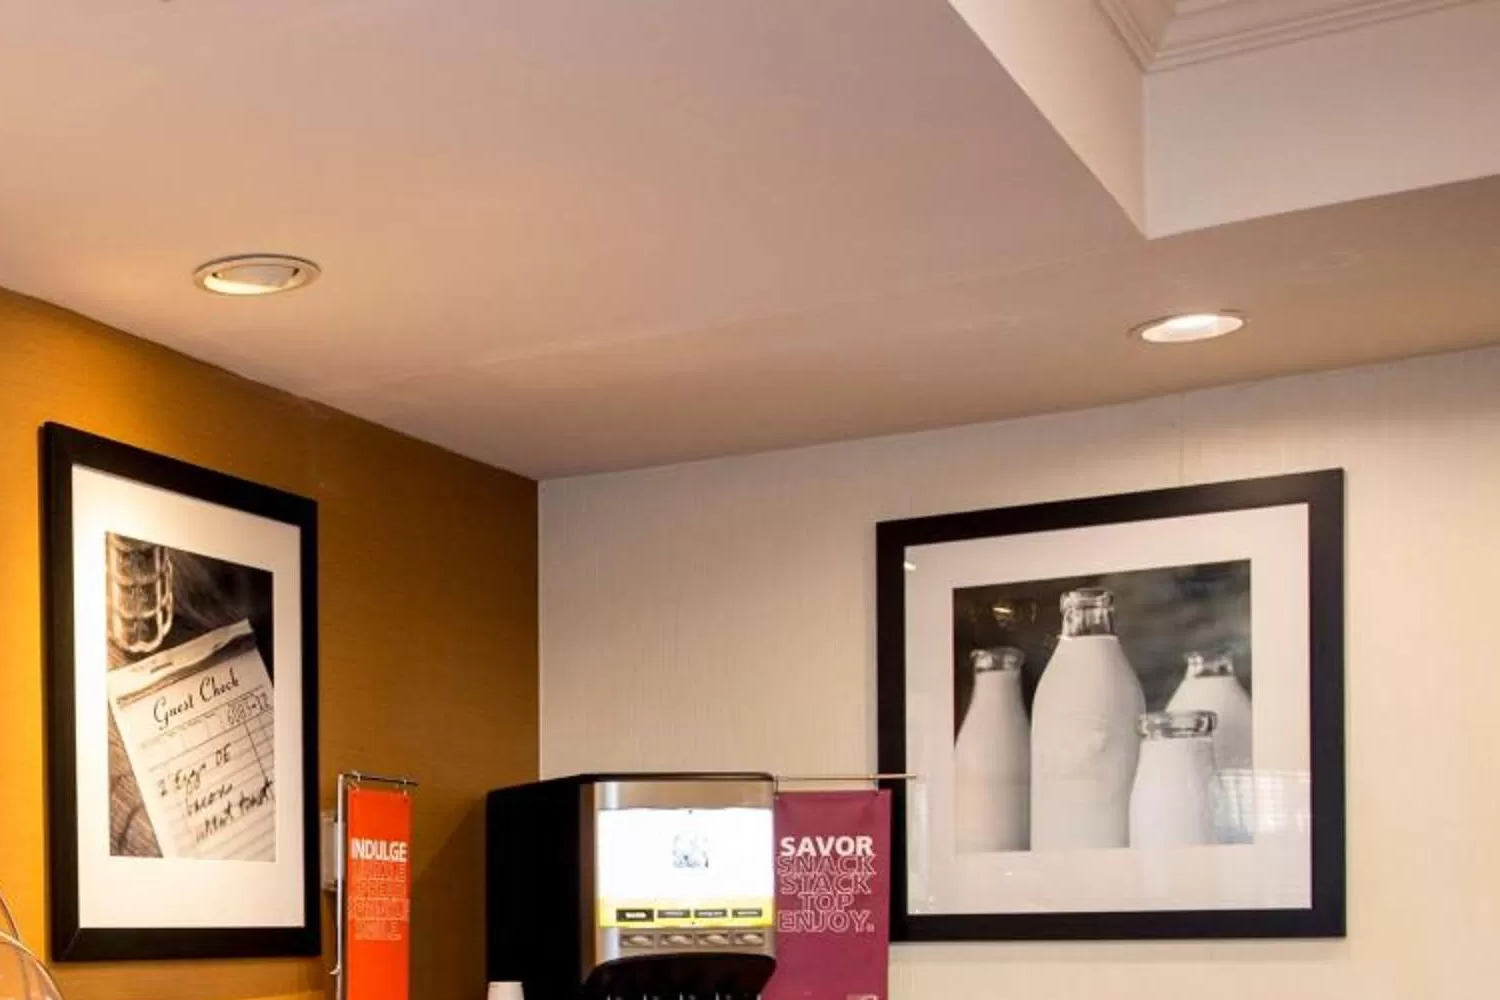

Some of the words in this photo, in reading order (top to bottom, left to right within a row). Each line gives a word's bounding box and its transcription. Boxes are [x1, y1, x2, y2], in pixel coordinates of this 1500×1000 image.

[153, 694, 195, 731] Guest
[199, 667, 240, 703] Check
[351, 838, 407, 863] INDULGE
[780, 835, 873, 857] SAVOR
[778, 854, 876, 876] SNACK
[780, 872, 872, 895] STACK
[798, 892, 854, 913] TOP
[778, 909, 875, 933] ENJOY.
